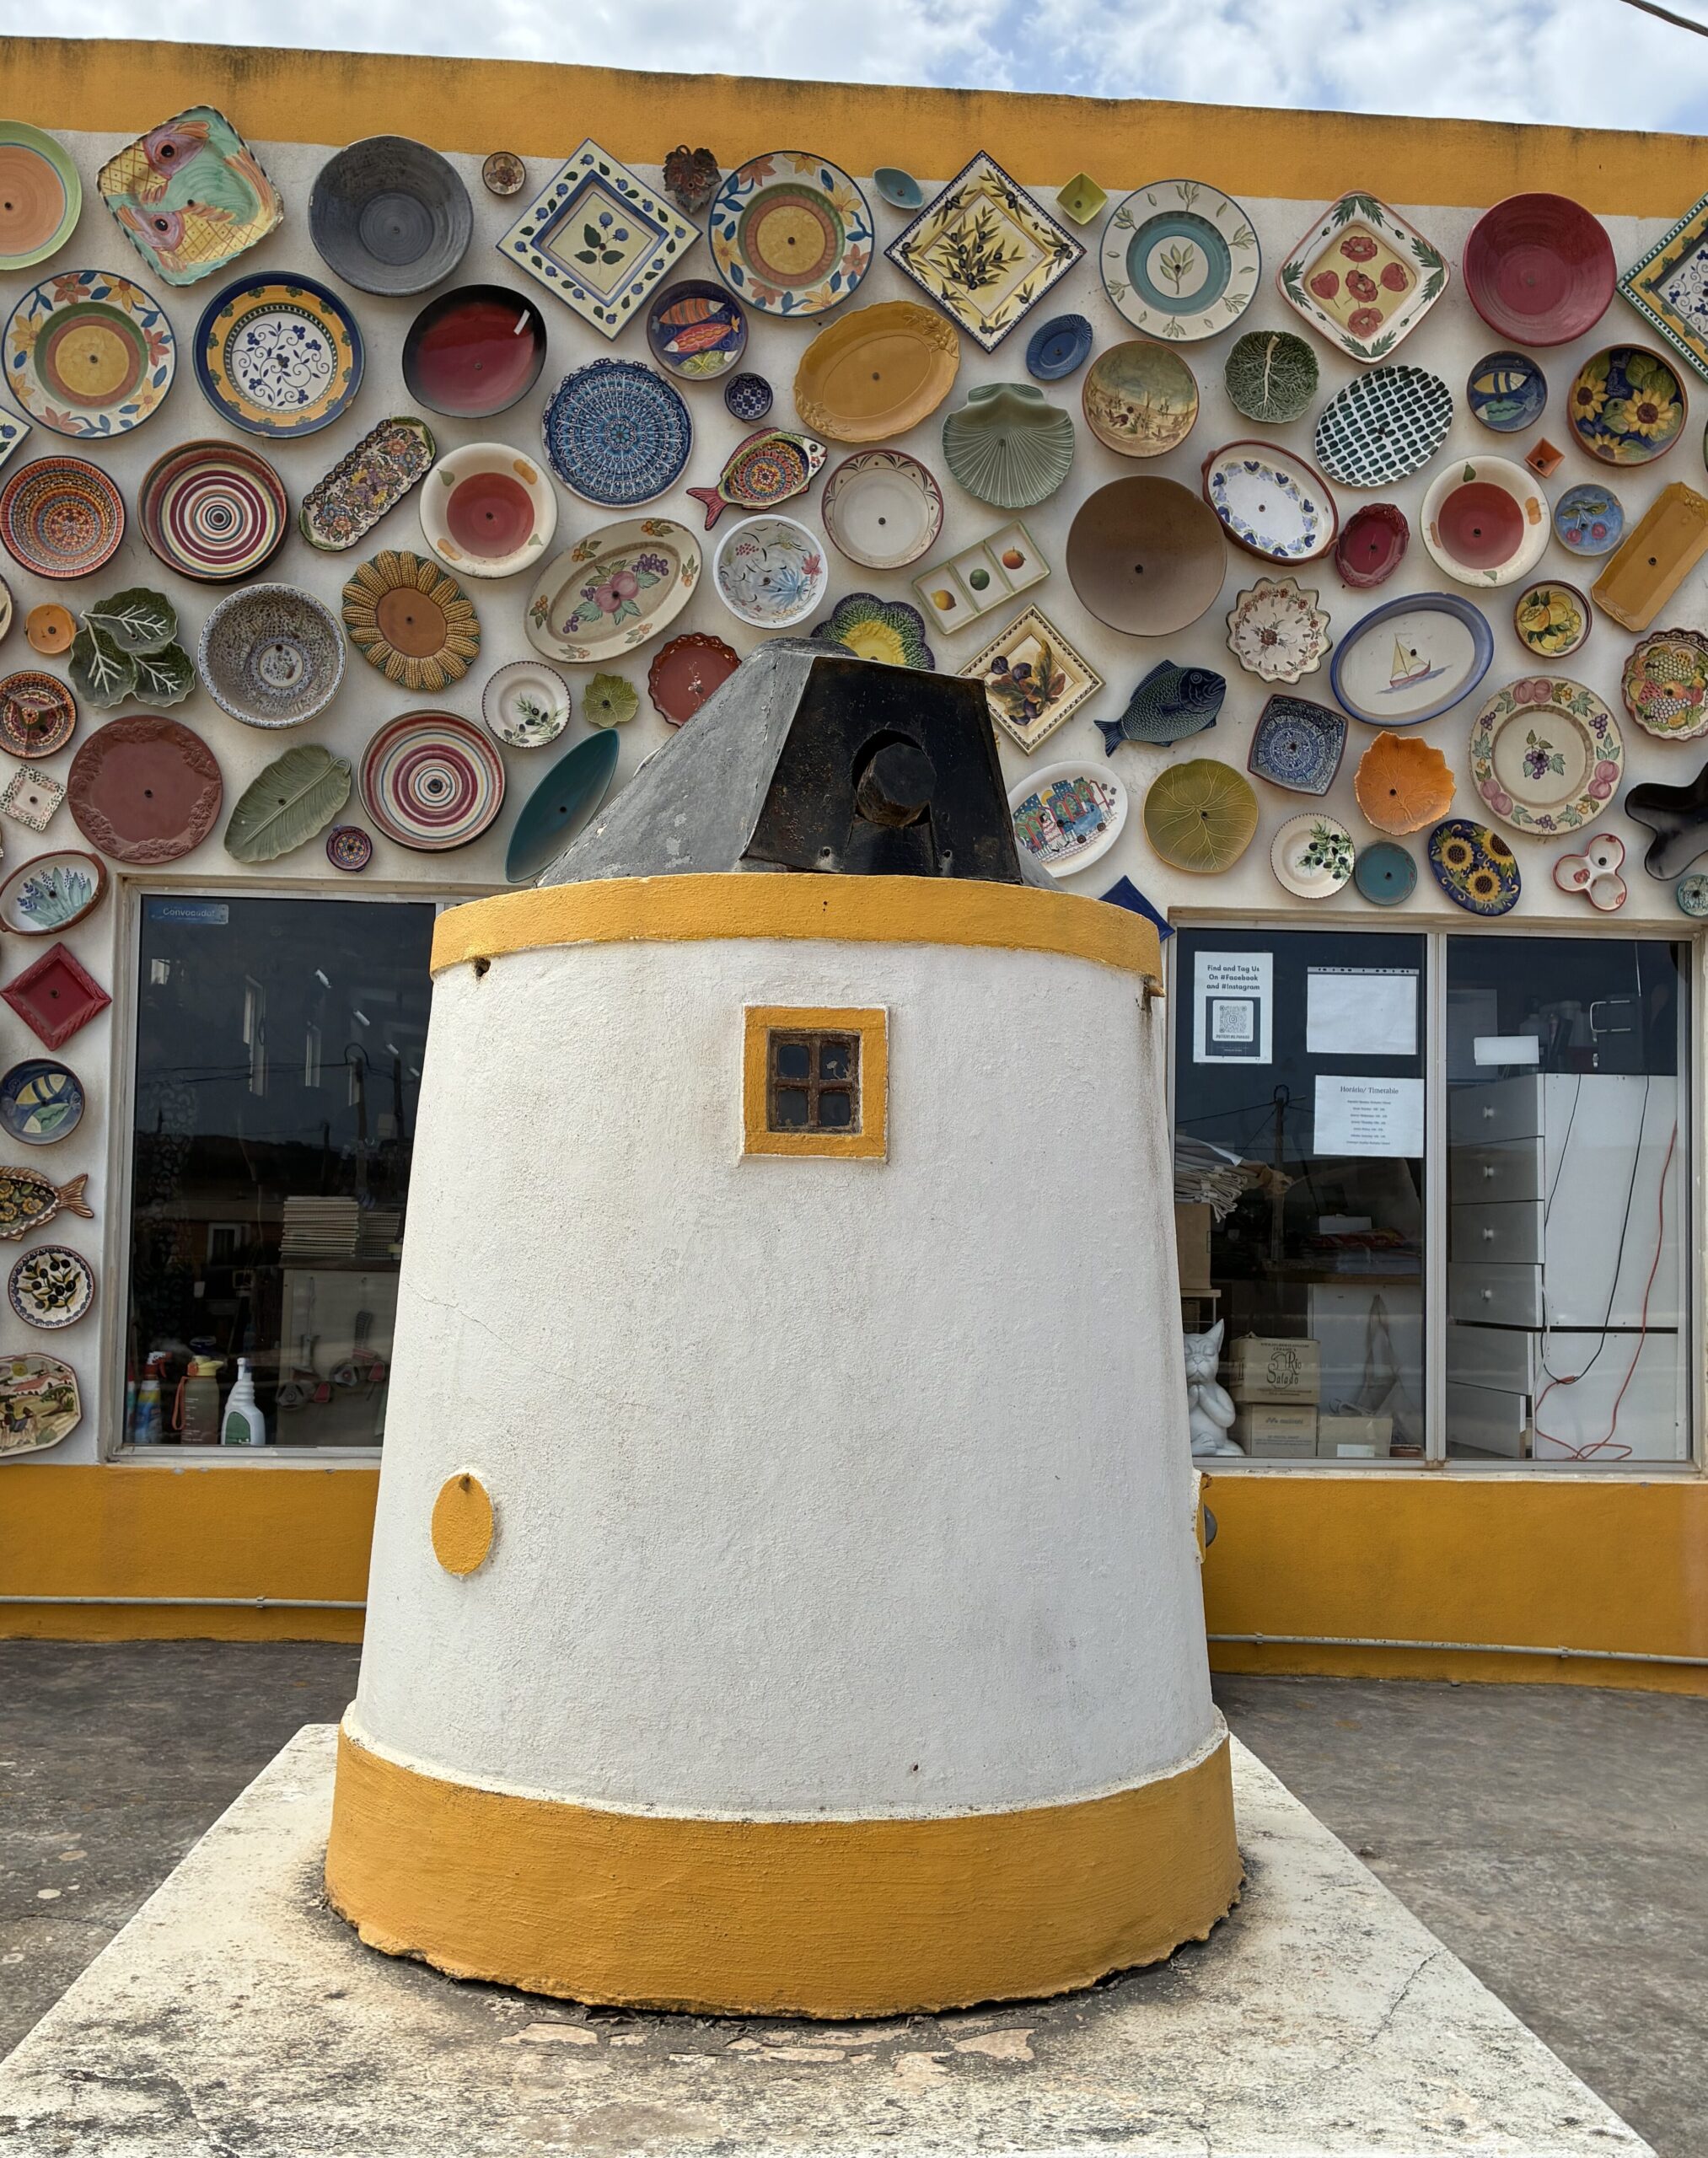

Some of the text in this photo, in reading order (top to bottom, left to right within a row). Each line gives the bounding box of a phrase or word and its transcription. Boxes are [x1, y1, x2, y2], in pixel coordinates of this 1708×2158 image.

[1238, 965, 1250, 974] Tag
[1222, 983, 1260, 991] #Instagram
[1266, 1362, 1299, 1384] Salado
